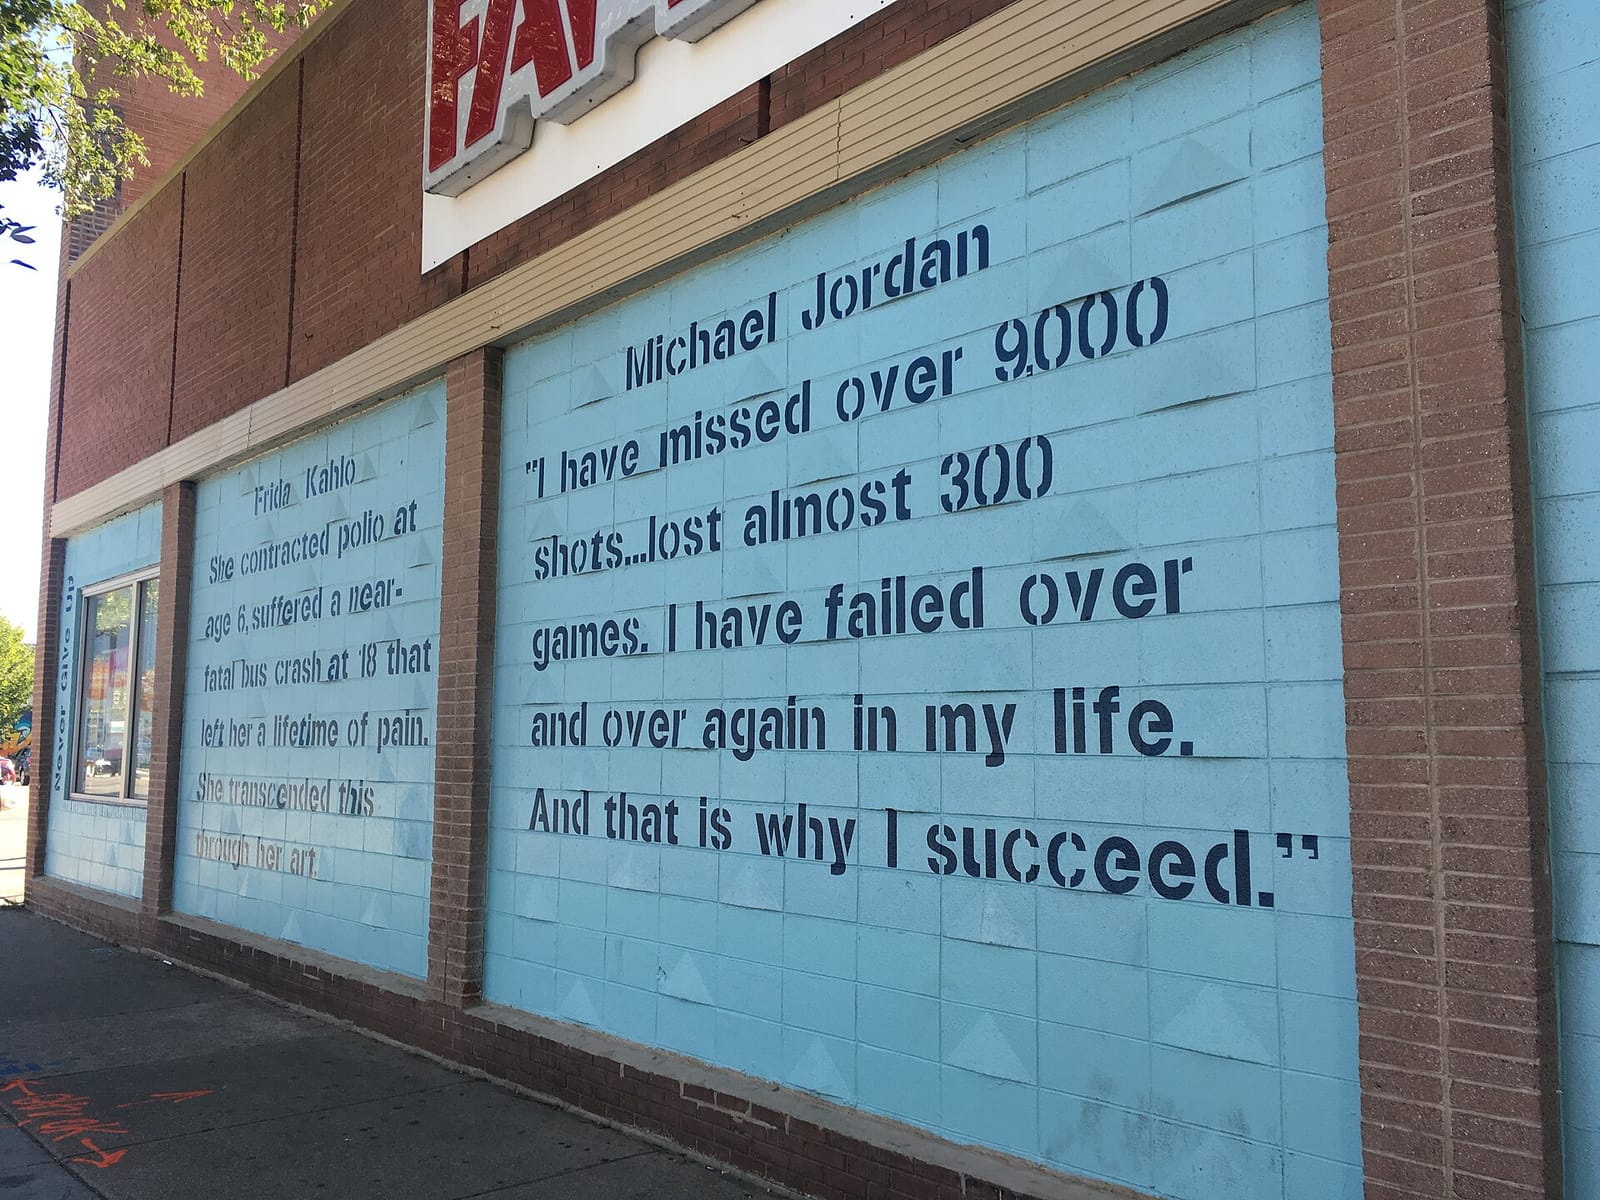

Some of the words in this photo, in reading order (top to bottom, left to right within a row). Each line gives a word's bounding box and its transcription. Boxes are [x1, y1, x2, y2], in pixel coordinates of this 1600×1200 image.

[625, 291, 777, 391] Michael
[801, 224, 990, 330] Jordan
[560, 439, 639, 493] have
[659, 379, 811, 468] missed
[836, 346, 963, 422] over
[995, 276, 1169, 382] 9,000
[254, 479, 291, 516] Frida
[305, 455, 356, 499] Kahlo
[743, 467, 912, 546] almost
[940, 434, 1053, 513] 300
[209, 555, 234, 584] She
[241, 524, 329, 576] contracted
[338, 510, 384, 559] polio
[393, 499, 418, 535] at
[205, 612, 231, 643] age
[252, 586, 323, 630] suffered
[330, 590, 341, 617] a
[349, 578, 403, 613] near-
[532, 617, 648, 671] games.
[668, 603, 676, 652] I
[695, 600, 803, 650] have
[825, 566, 984, 639] failed
[1019, 556, 1193, 626] over
[60, 627, 72, 692] Give
[204, 660, 235, 692] fatal
[241, 659, 267, 688] bus
[274, 651, 321, 685] crash
[327, 649, 349, 682] at
[359, 642, 377, 678] 18
[386, 638, 431, 675] that
[55, 705, 66, 792] Never
[200, 718, 224, 747] left
[228, 718, 253, 747] her
[256, 720, 266, 747] a
[273, 713, 338, 747] lifetime
[347, 711, 368, 747] of
[377, 709, 428, 753] pain.
[531, 701, 588, 747] and
[602, 708, 687, 748] over
[702, 695, 826, 761] again
[853, 693, 898, 751] in
[925, 703, 1017, 768] my
[1053, 685, 1194, 757] life.
[197, 772, 223, 802] She
[228, 777, 331, 813] transcended
[338, 779, 374, 817] this
[528, 788, 589, 835] And
[604, 791, 679, 845] that
[699, 796, 732, 850] is
[755, 803, 856, 876] why
[886, 808, 898, 868] I
[196, 829, 249, 870] through
[256, 836, 282, 871] her
[290, 846, 318, 879] art.
